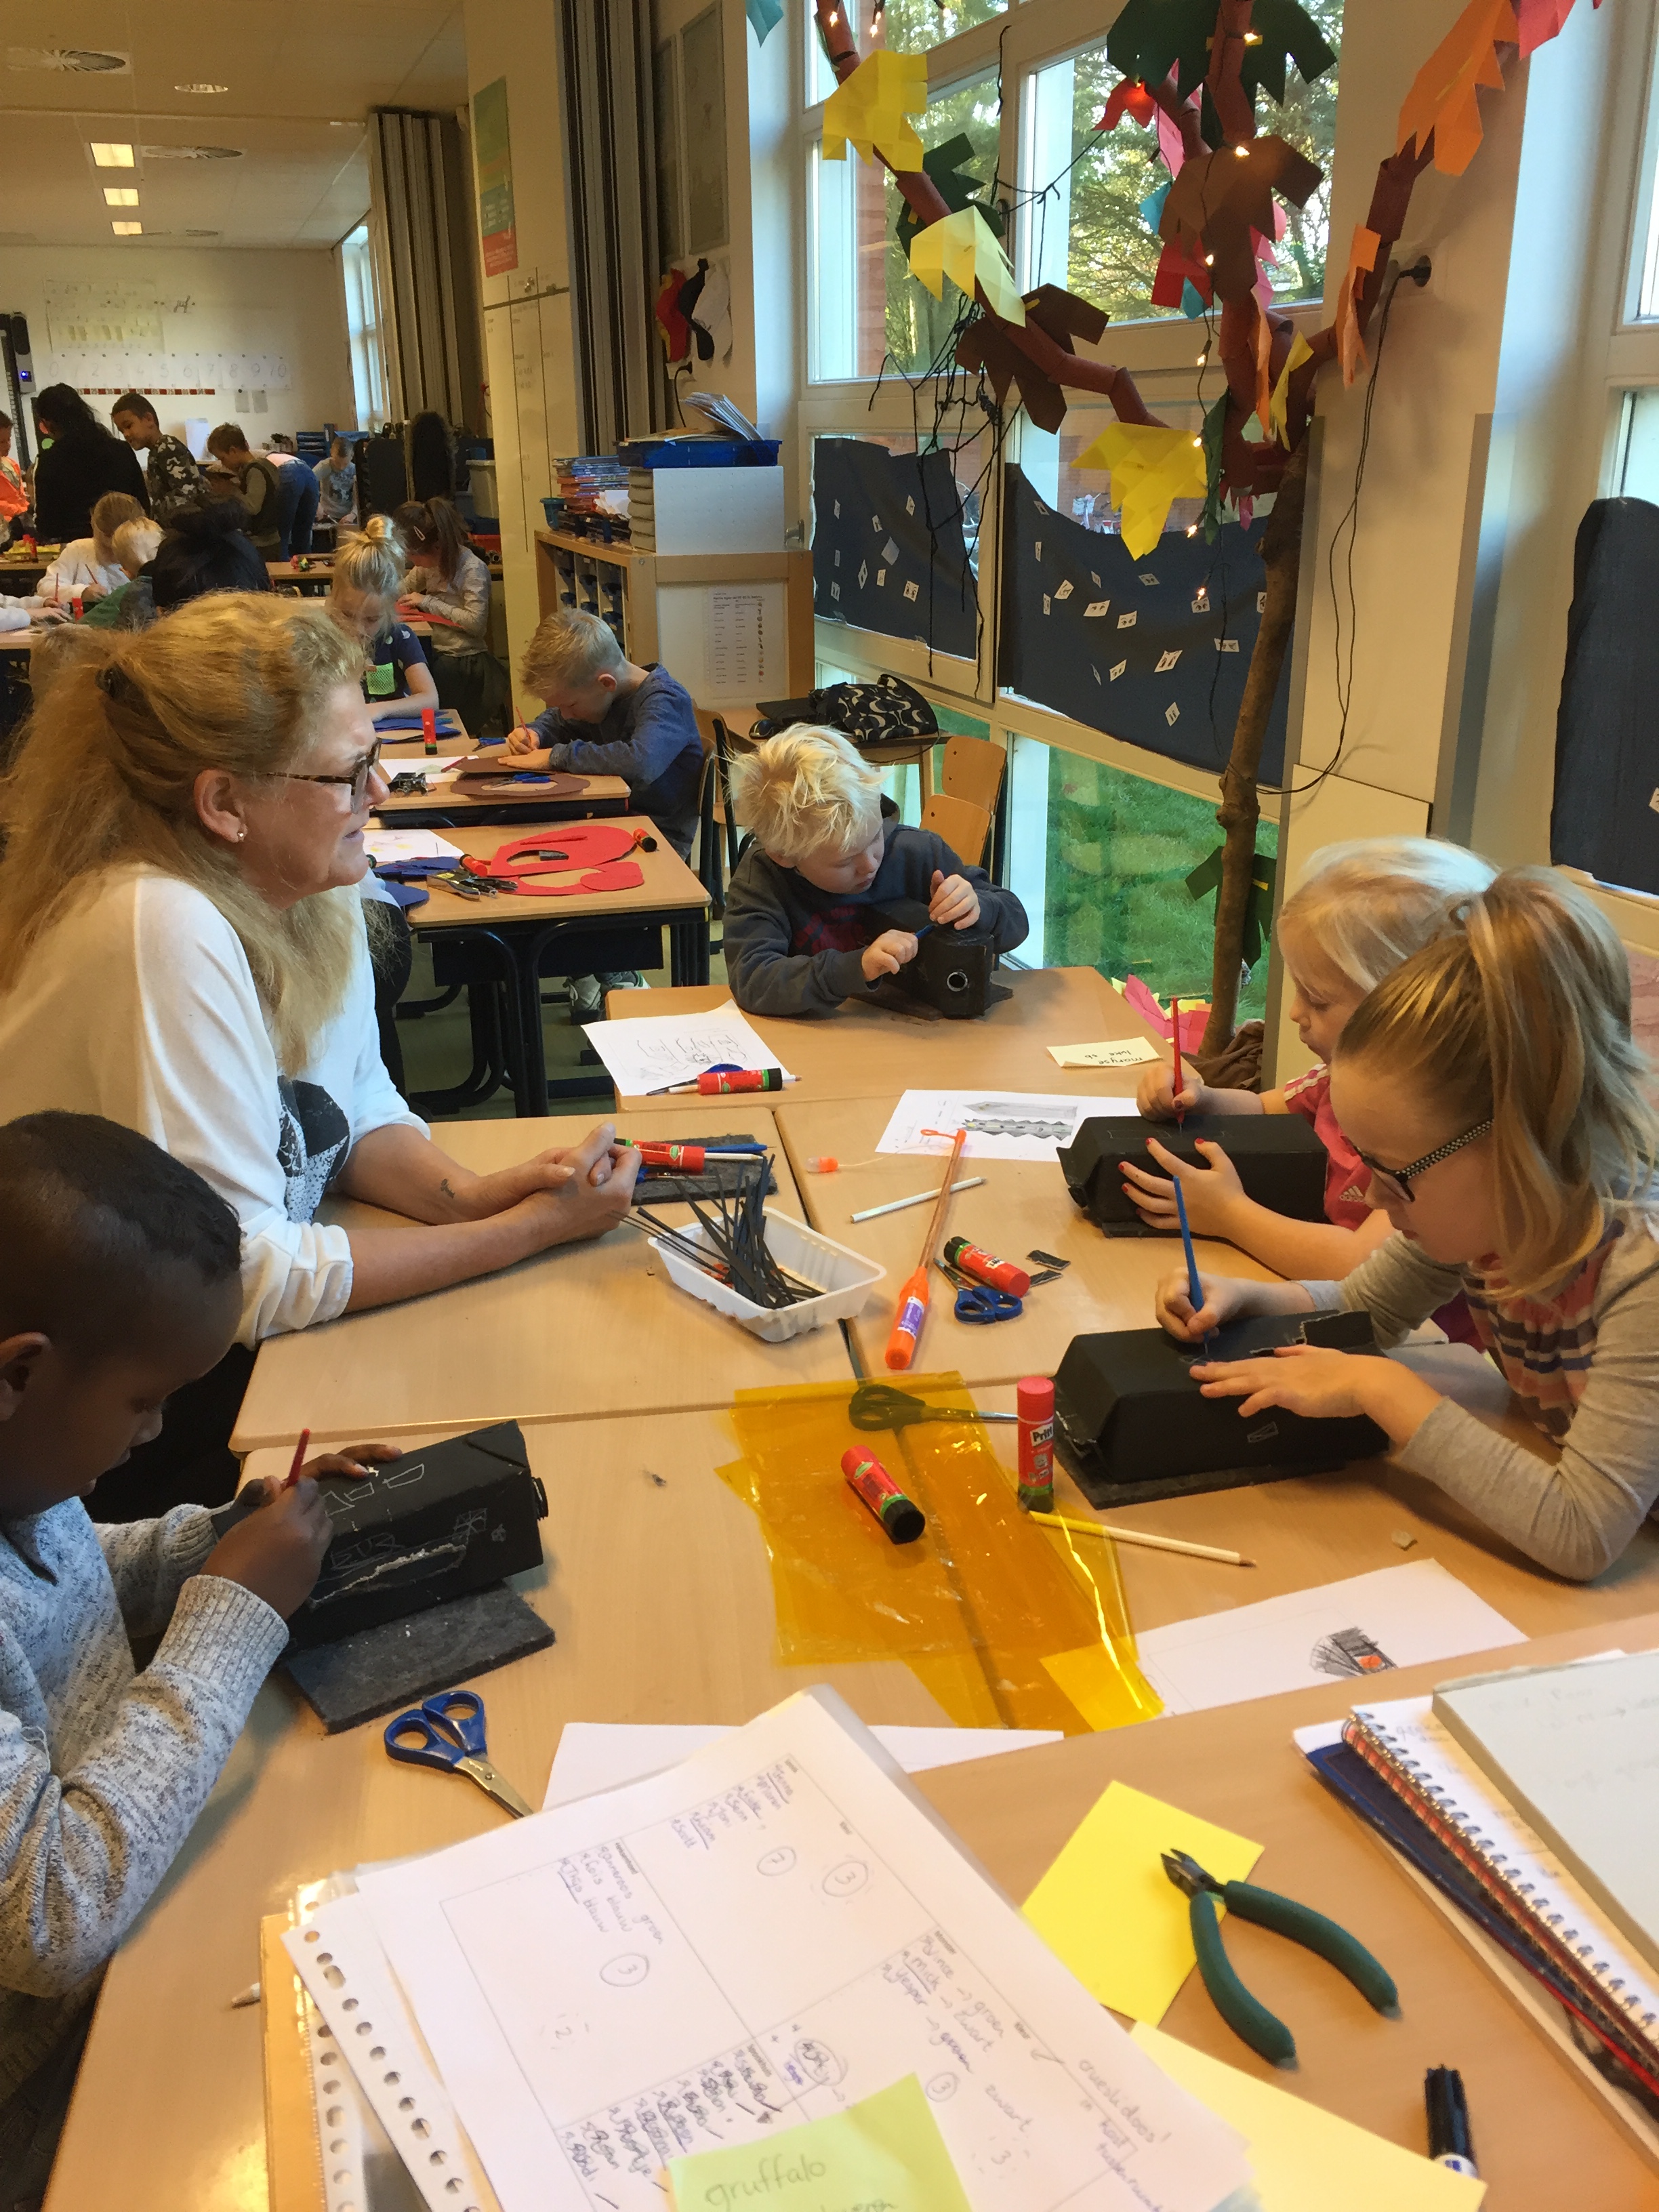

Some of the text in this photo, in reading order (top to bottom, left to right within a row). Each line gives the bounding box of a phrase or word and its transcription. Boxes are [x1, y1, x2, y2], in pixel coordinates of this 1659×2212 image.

[49, 362, 58, 377] 0
[91, 363, 99, 377] 2
[115, 363, 123, 377] 3
[137, 363, 144, 375] 4
[160, 363, 169, 377] 5
[183, 363, 192, 377] 6
[207, 363, 214, 375] 7
[230, 363, 237, 377] 8
[251, 363, 260, 377] 9
[270, 364, 286, 377] 10
[1099, 1057, 1143, 1065] maryse
[554, 2026, 572, 2040] 2
[991, 2150, 1011, 2165] 3
[705, 2154, 827, 2212] gruffalo
